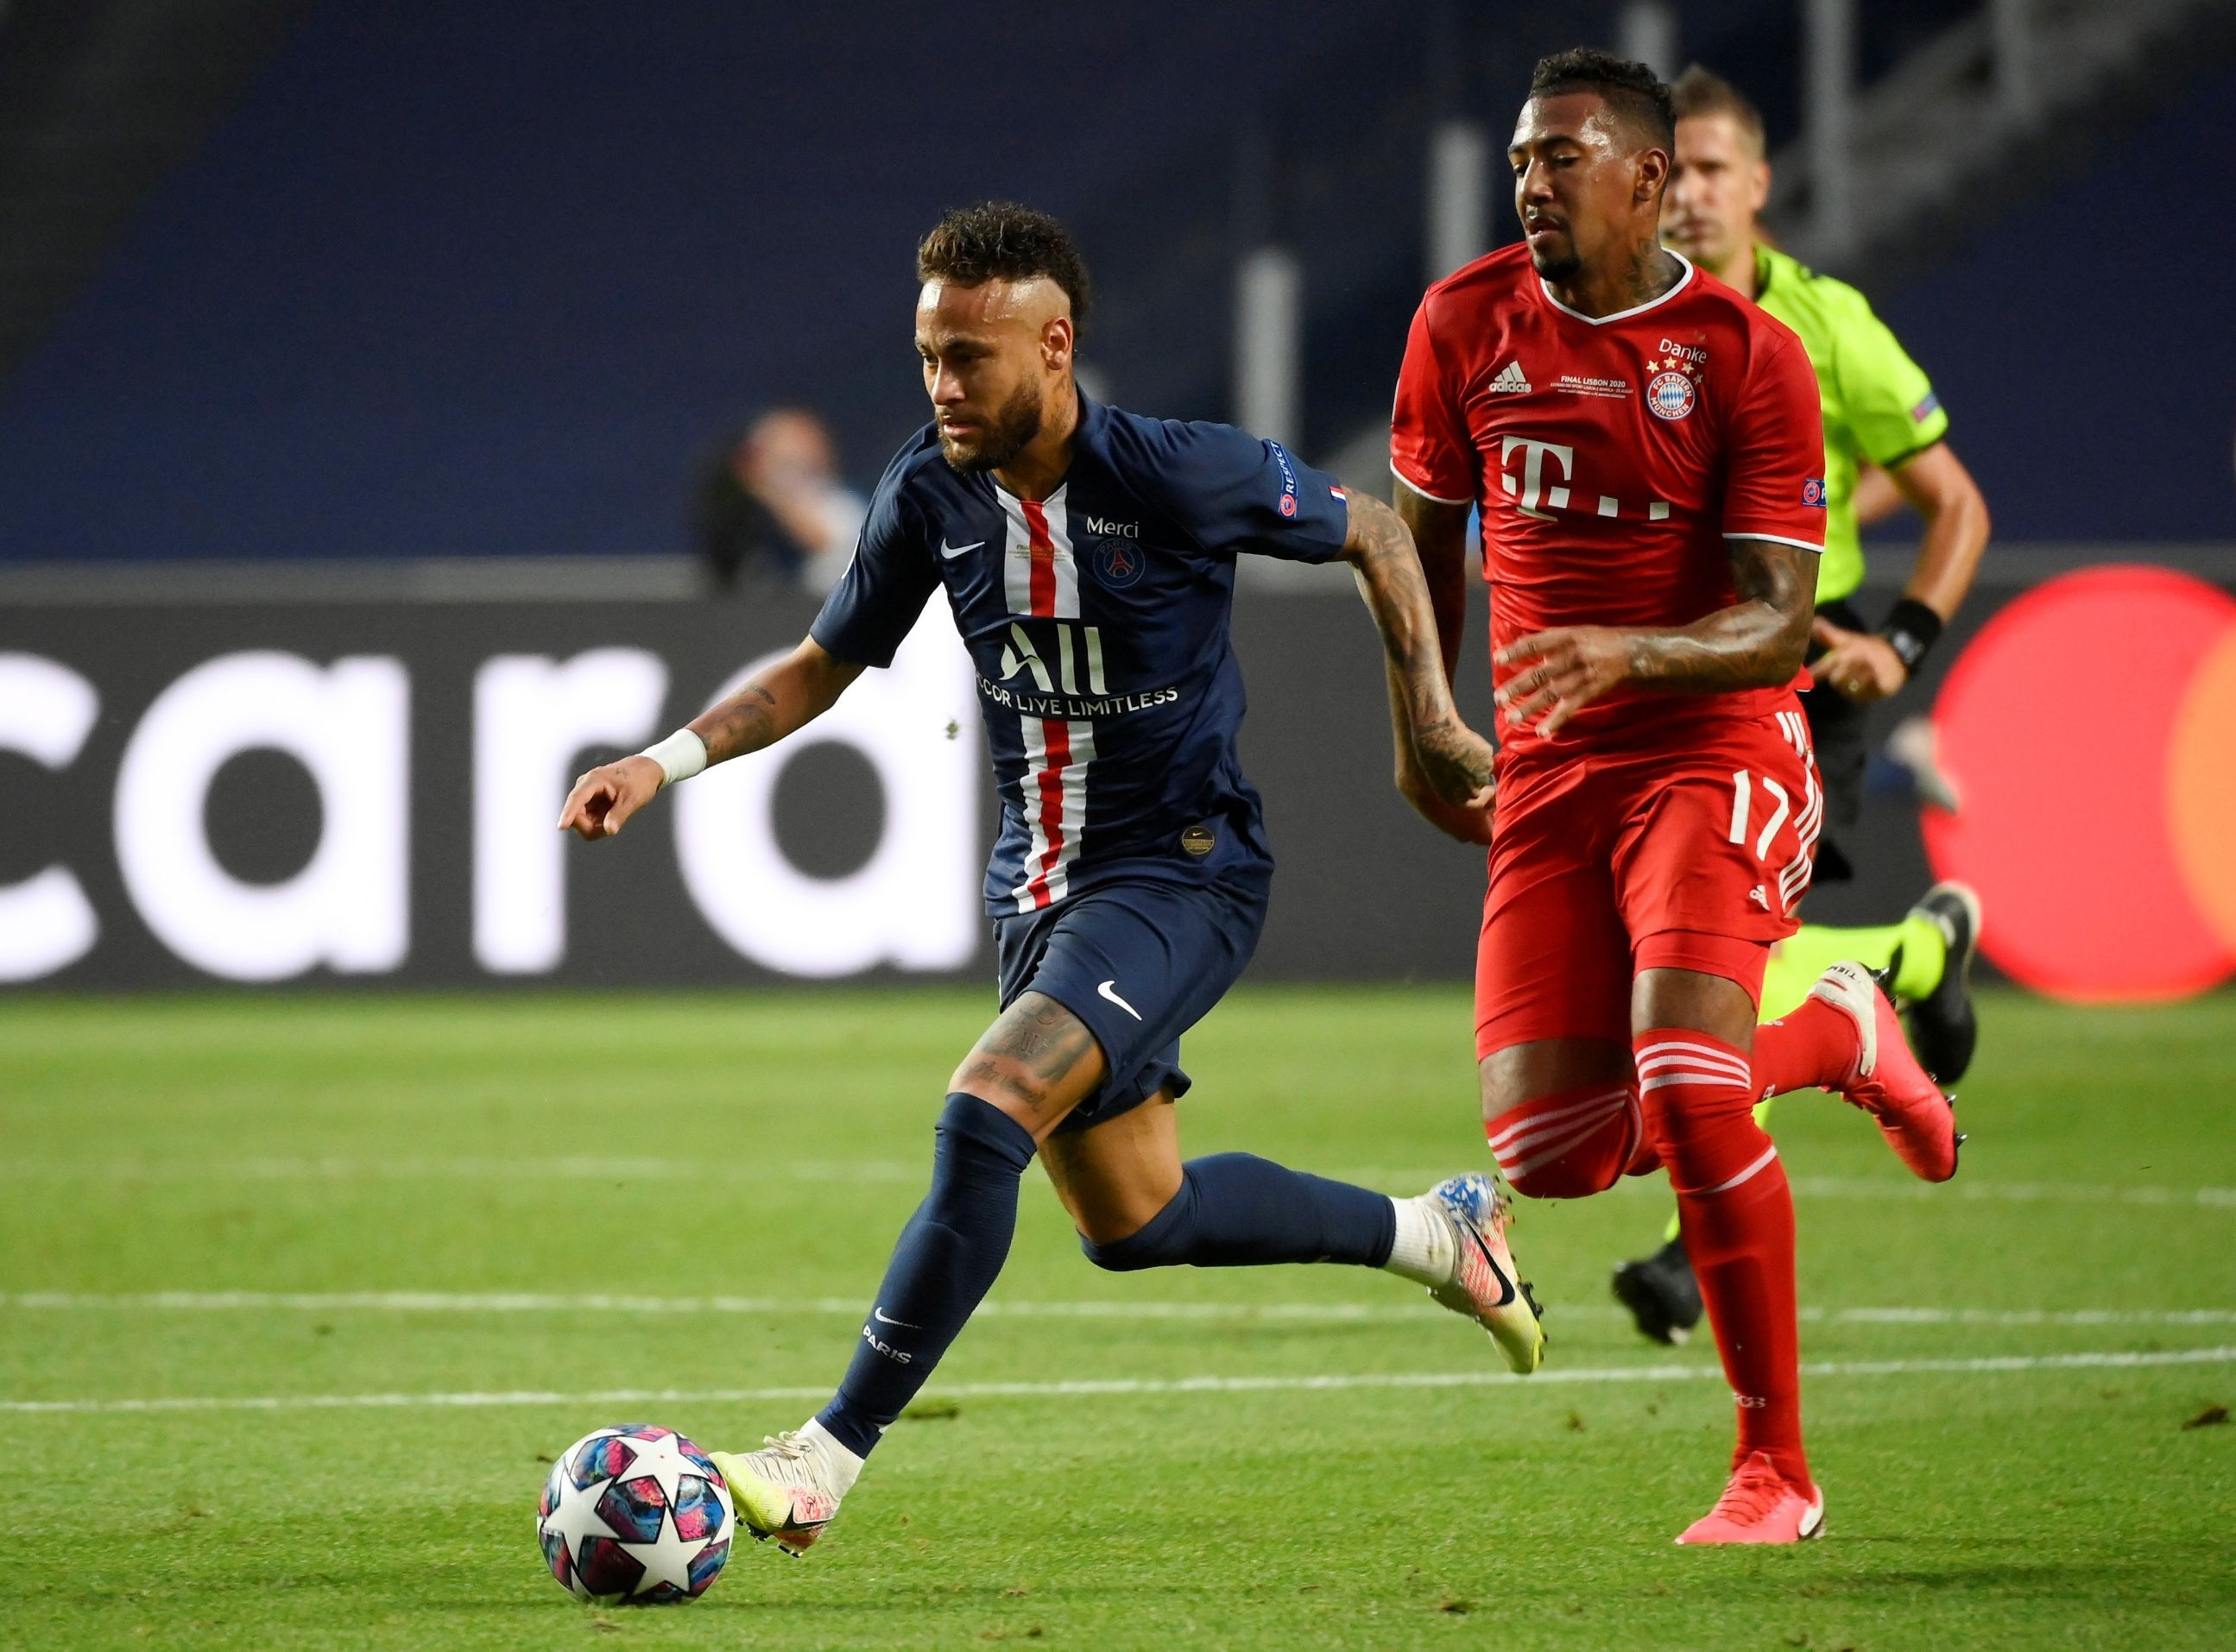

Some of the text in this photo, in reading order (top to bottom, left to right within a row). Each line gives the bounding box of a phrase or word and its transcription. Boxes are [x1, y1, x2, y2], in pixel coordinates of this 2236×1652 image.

[1658, 338, 1707, 363] Danke
[1488, 381, 1532, 394] adidas
[1560, 375, 1582, 384] FINAL
[1582, 377, 1608, 387] LISBON
[1653, 379, 1664, 390] FC
[1664, 375, 1692, 397] BAYERN
[1269, 440, 1295, 494] RESPECT
[1086, 516, 1139, 539] Merci
[976, 672, 1179, 716] CCOR LIVE LIMITLESS
[1728, 768, 1790, 861] 17
[863, 1324, 913, 1365] PARIS
